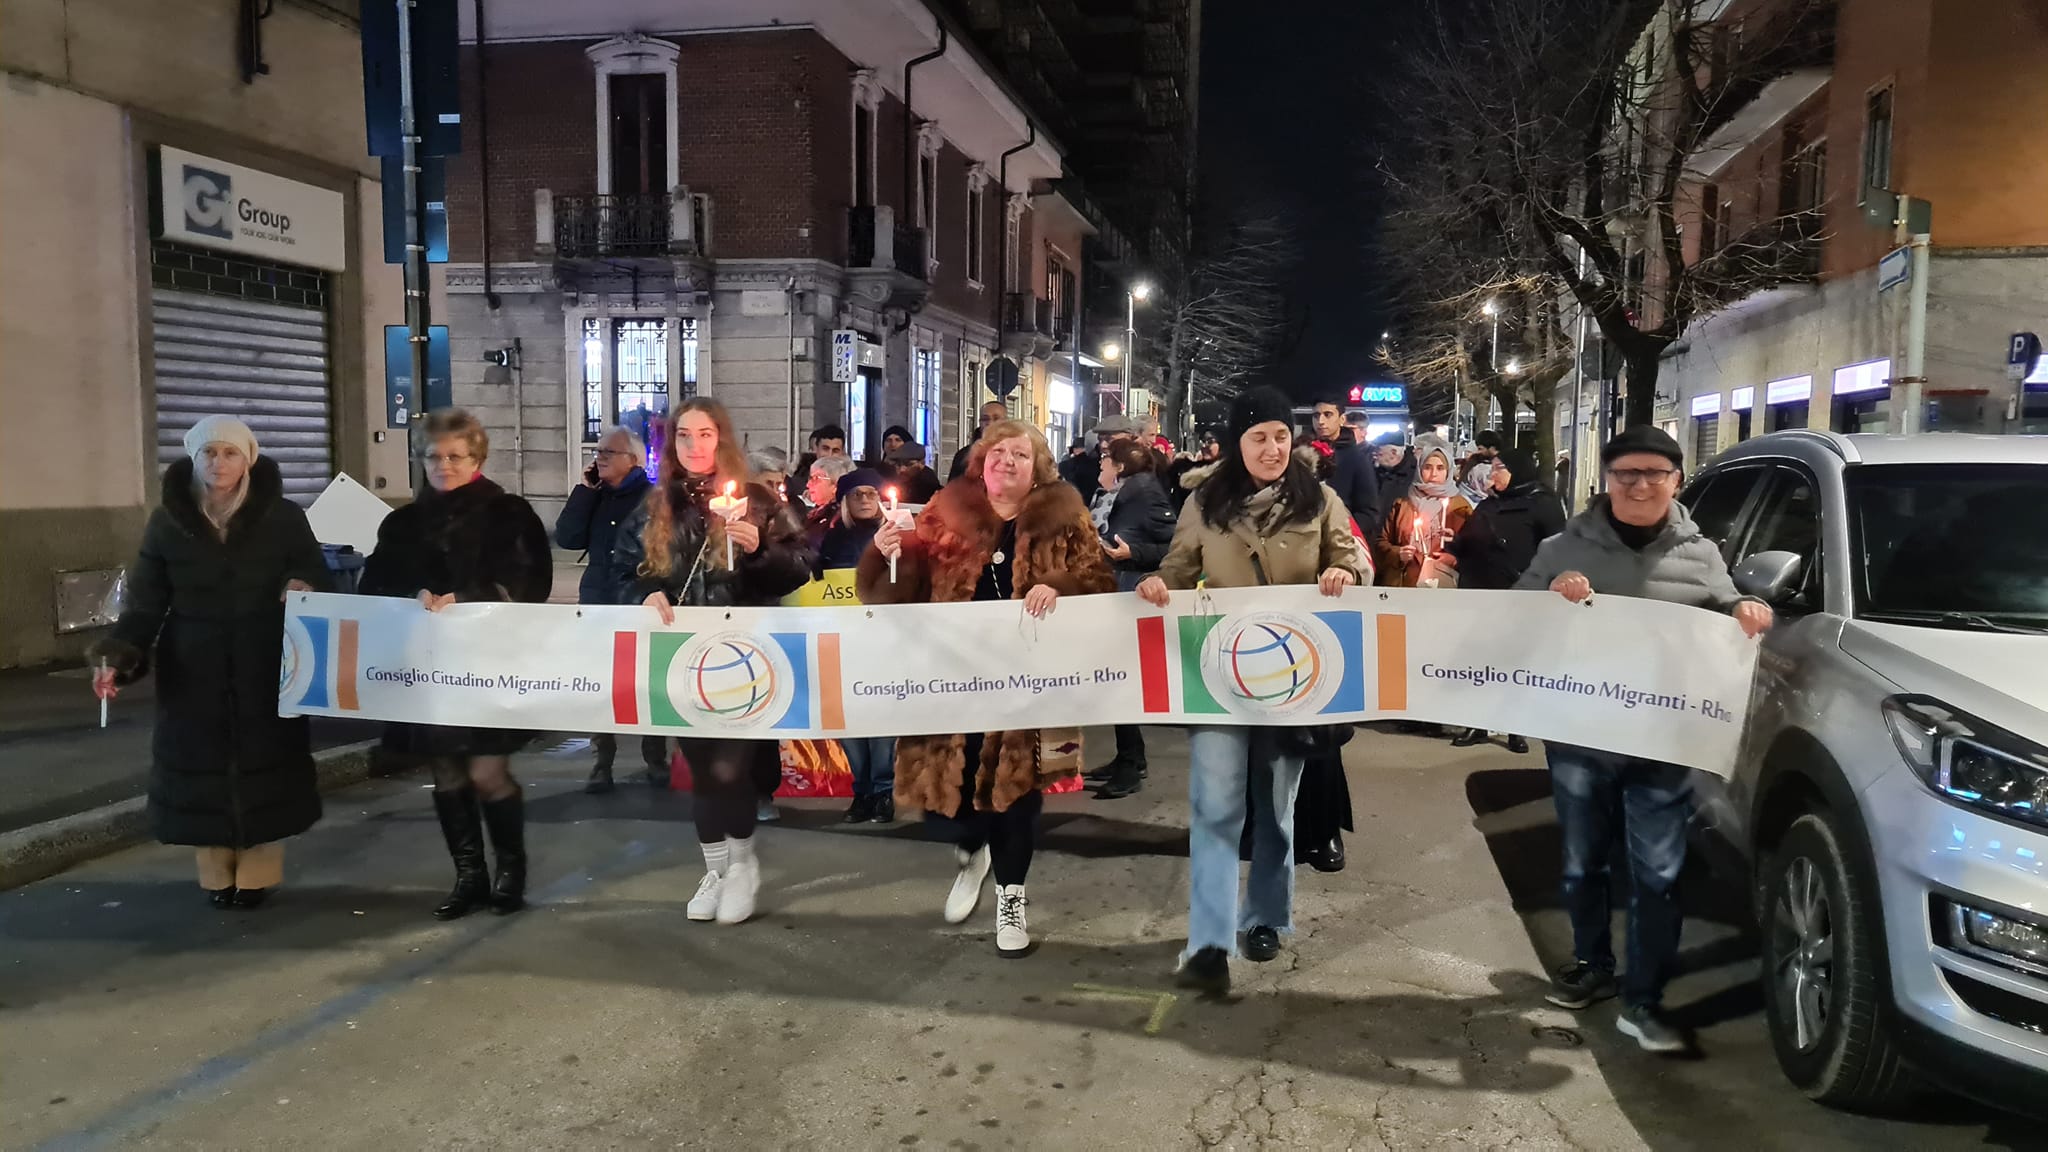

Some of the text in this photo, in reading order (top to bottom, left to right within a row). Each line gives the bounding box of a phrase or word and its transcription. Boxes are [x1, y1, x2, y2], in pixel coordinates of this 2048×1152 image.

[238, 198, 291, 233] Group
[2012, 336, 2024, 361] P
[1362, 387, 1402, 401] AVIS
[366, 666, 429, 687] Consiglio
[432, 670, 494, 689] Cittadino
[497, 674, 561, 695] Migranti
[572, 676, 601, 692] Rho
[852, 680, 925, 700] Consiglio
[928, 676, 1005, 694] Cittadino
[1008, 672, 1081, 694] Migranti
[1094, 667, 1127, 684] Rho
[1421, 663, 1508, 687] Consiglio
[1512, 669, 1596, 695] Cittadino
[1598, 681, 1687, 710] Migranti
